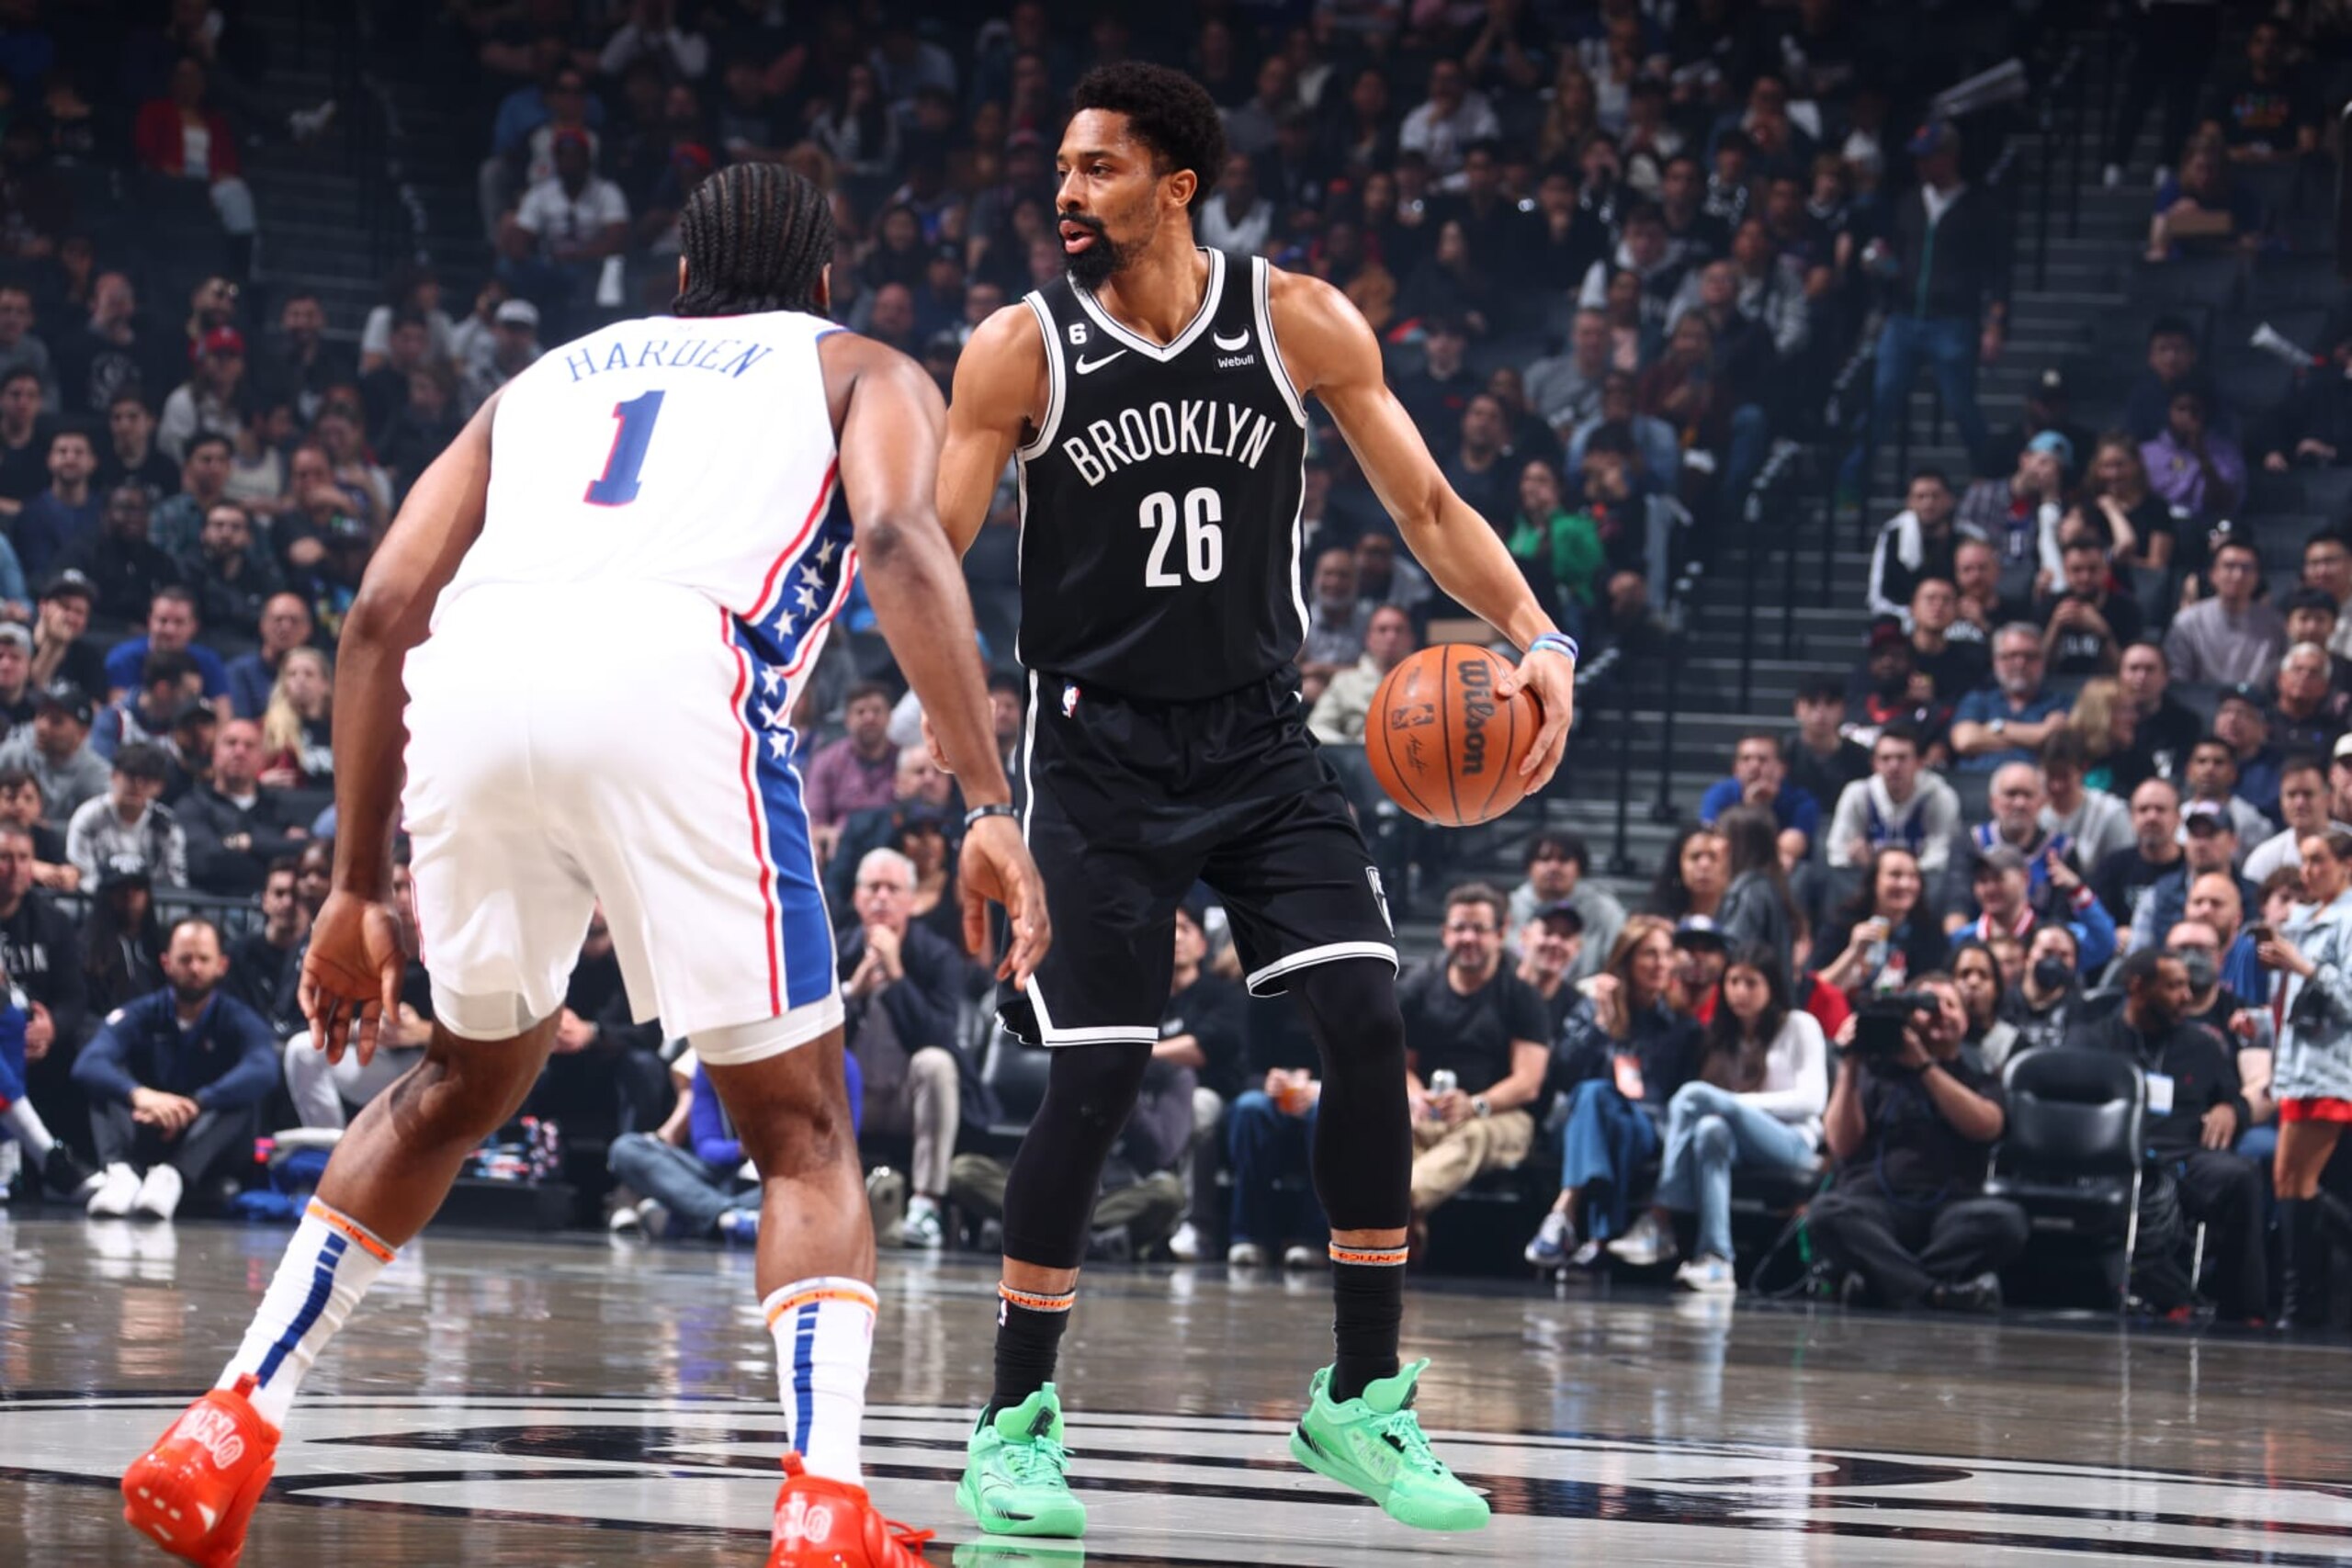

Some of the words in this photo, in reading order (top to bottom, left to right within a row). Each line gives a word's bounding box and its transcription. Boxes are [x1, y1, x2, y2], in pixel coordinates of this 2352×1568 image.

[565, 339, 774, 382] HARDEN
[1069, 323, 1087, 345] 6
[1217, 354, 1254, 368] Webull
[583, 389, 666, 507] 1
[1062, 400, 1276, 487] BROOKLYN
[1139, 487, 1223, 587] 26
[1457, 659, 1496, 775] Wilson
